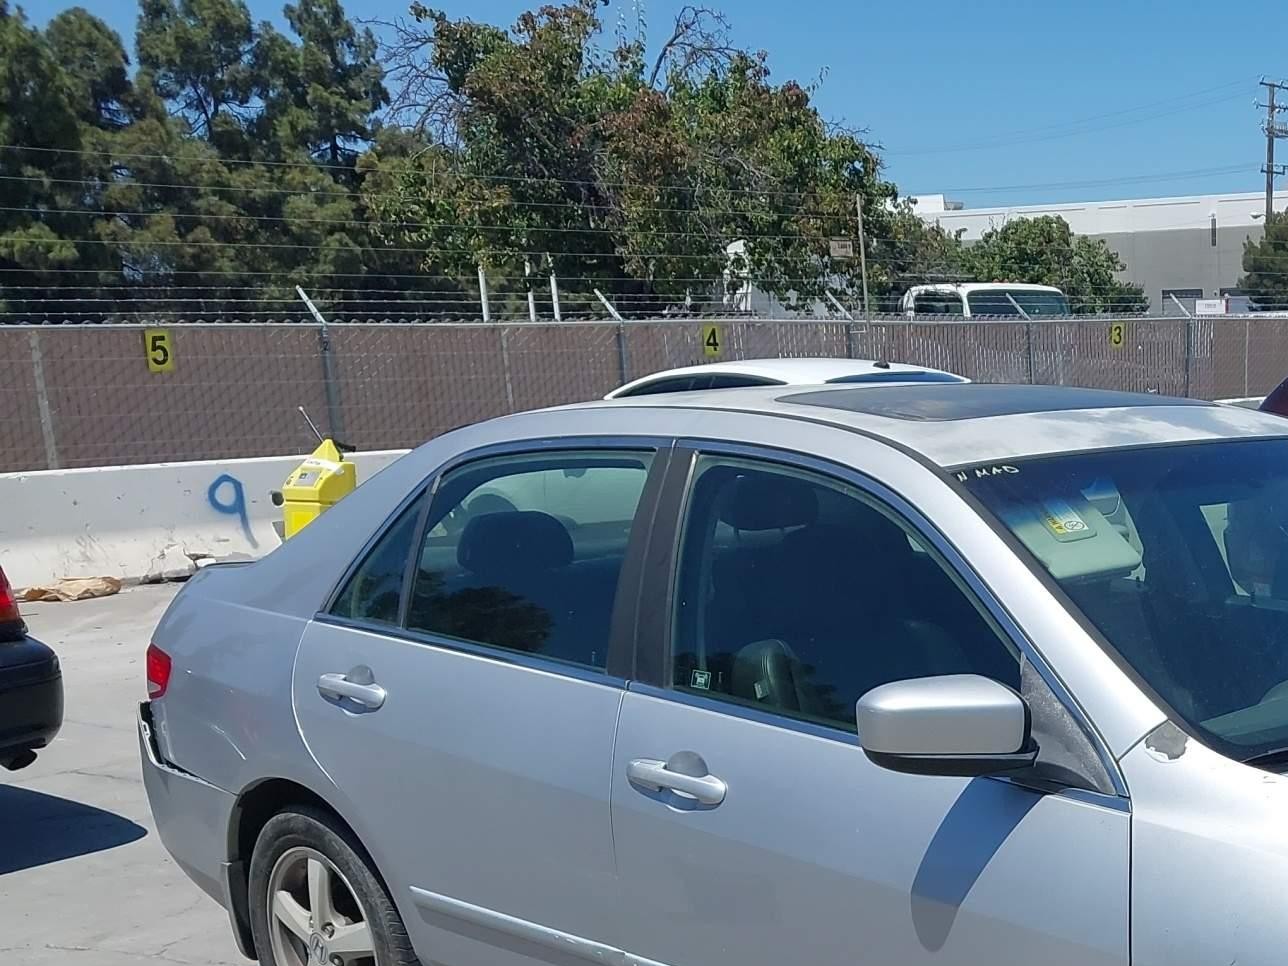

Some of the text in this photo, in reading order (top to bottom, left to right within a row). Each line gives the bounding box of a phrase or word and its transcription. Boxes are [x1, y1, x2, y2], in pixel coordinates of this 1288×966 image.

[707, 328, 719, 351] 4
[1113, 326, 1122, 344] 3
[151, 335, 168, 365] 5
[208, 474, 258, 549] 9
